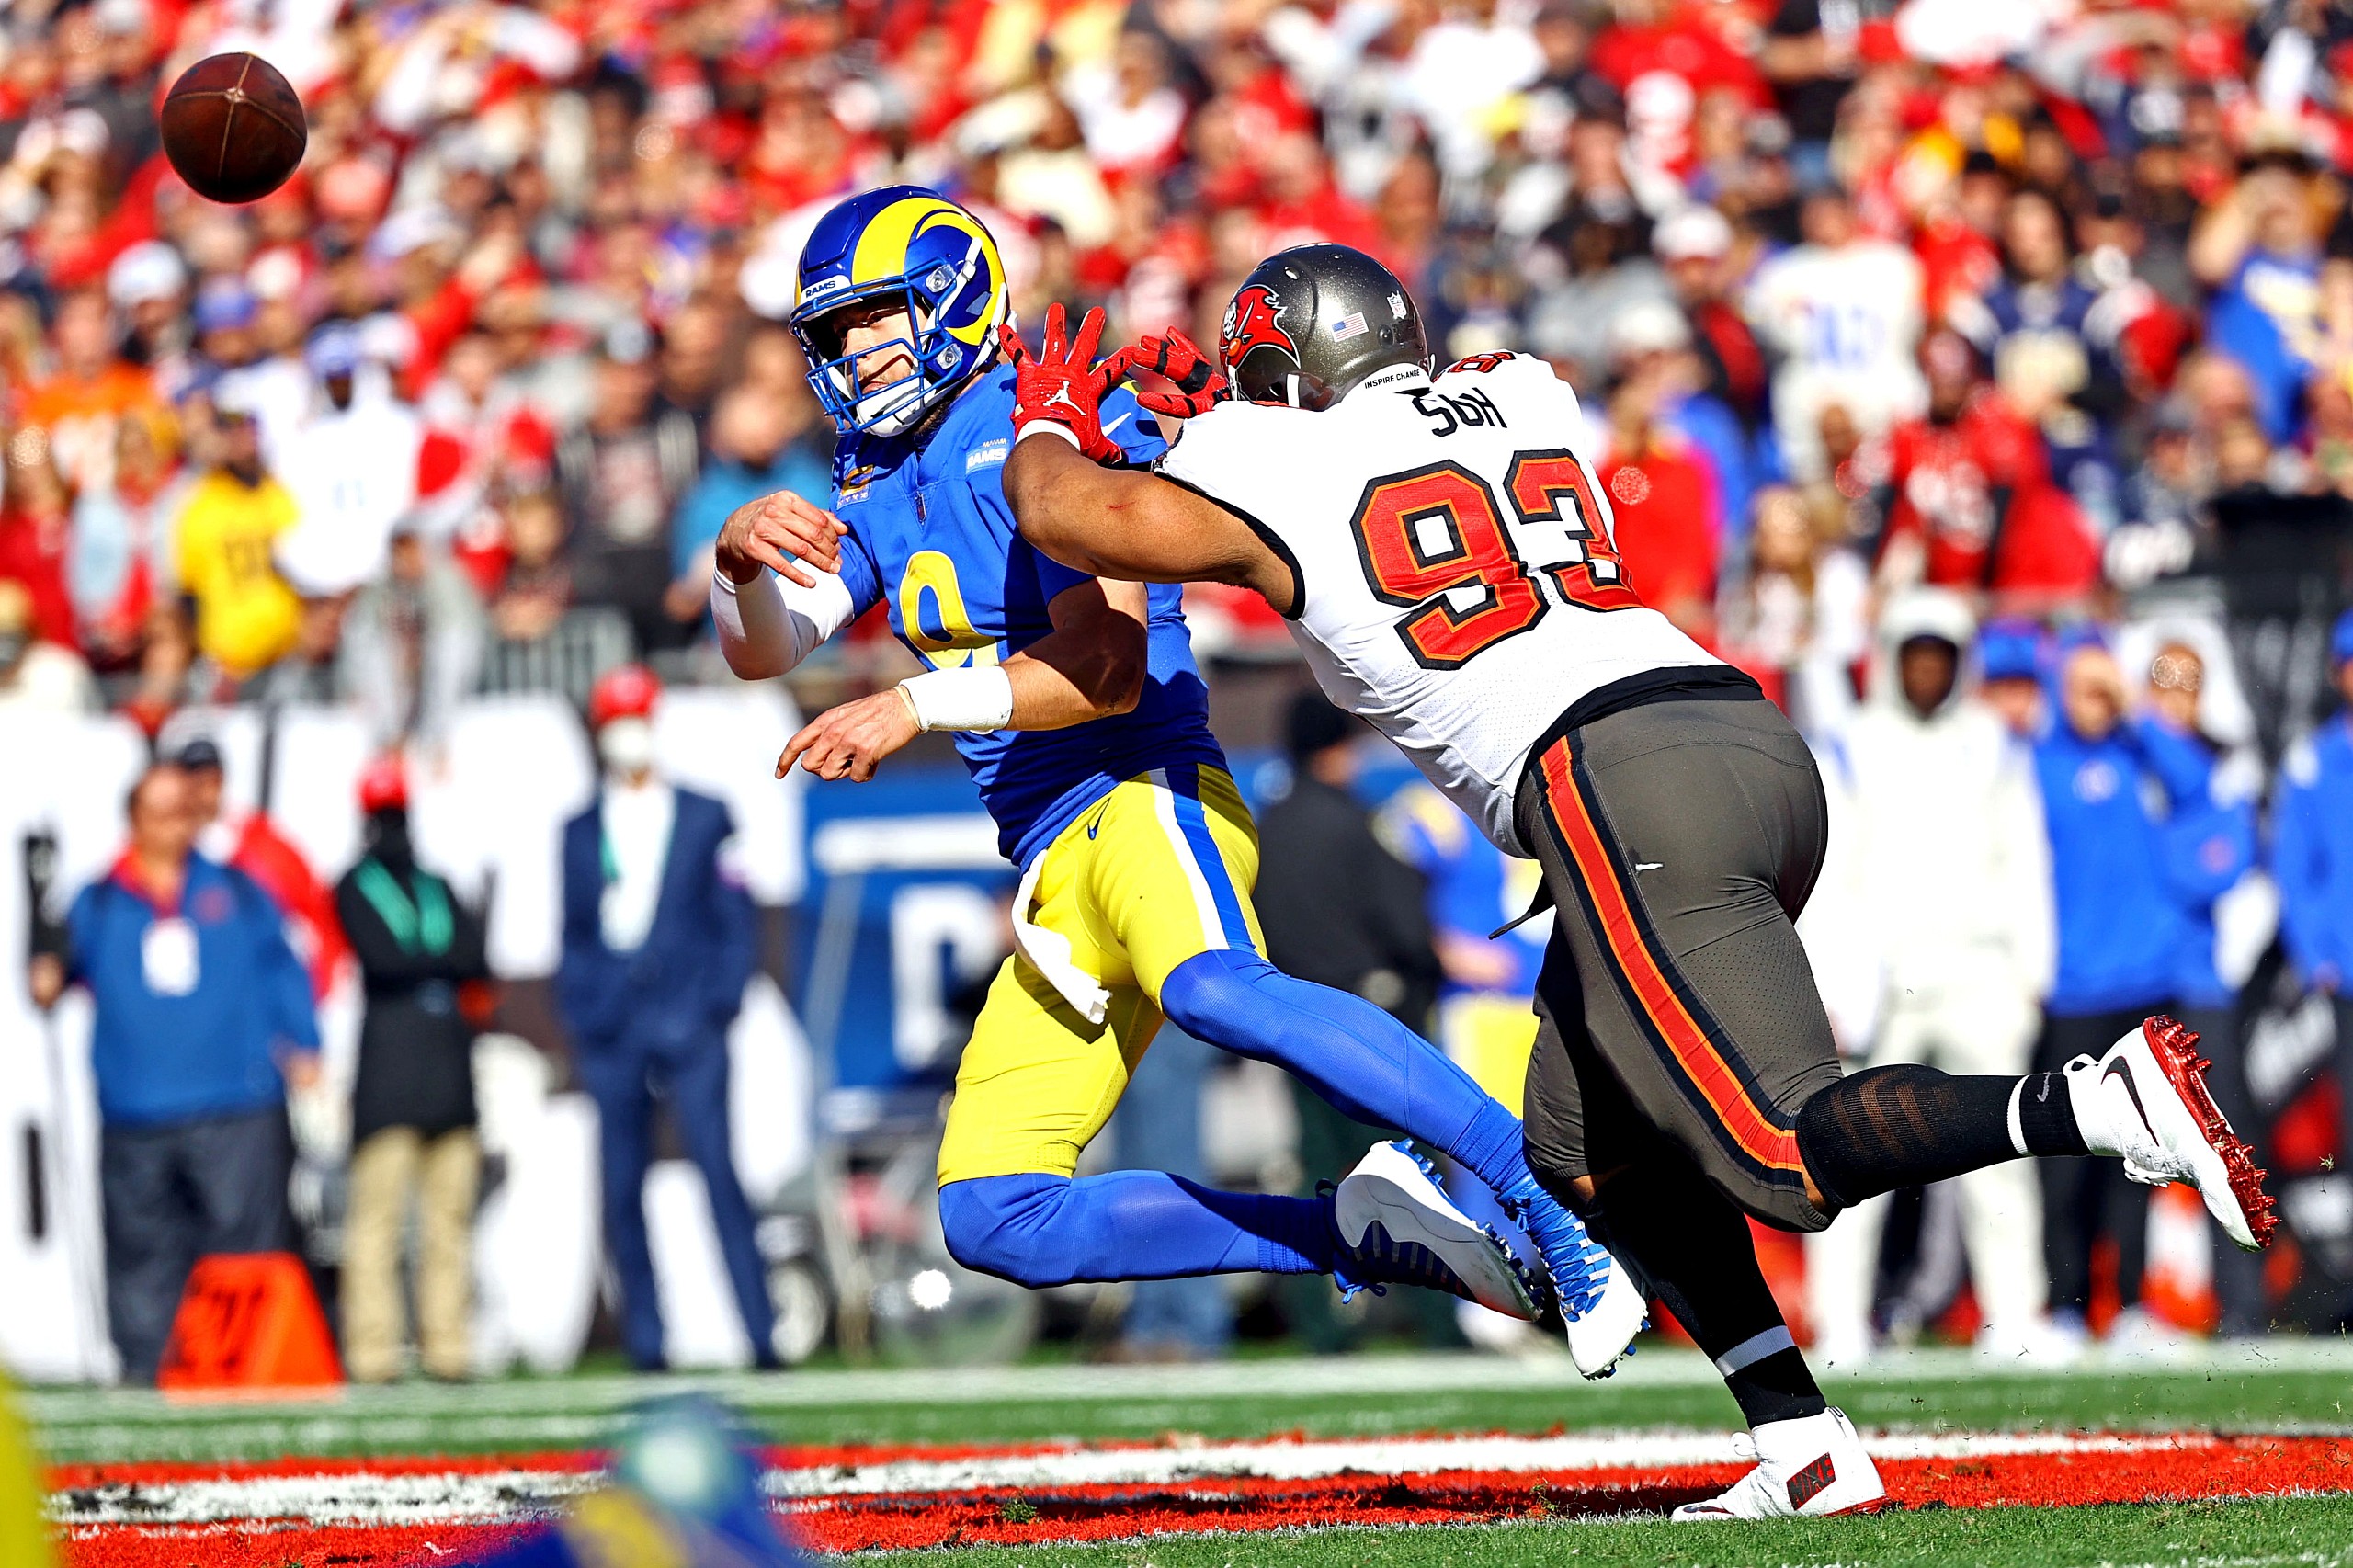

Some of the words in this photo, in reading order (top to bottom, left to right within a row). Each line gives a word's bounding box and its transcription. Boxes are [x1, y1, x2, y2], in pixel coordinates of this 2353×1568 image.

[805, 280, 835, 298] RAMS
[1364, 374, 1395, 390] INSPIRE
[1395, 369, 1420, 381] CHANGE
[1412, 387, 1508, 437] SUH
[967, 448, 1006, 470] RAMS
[1349, 448, 1652, 671] 93
[899, 550, 1000, 671] 9
